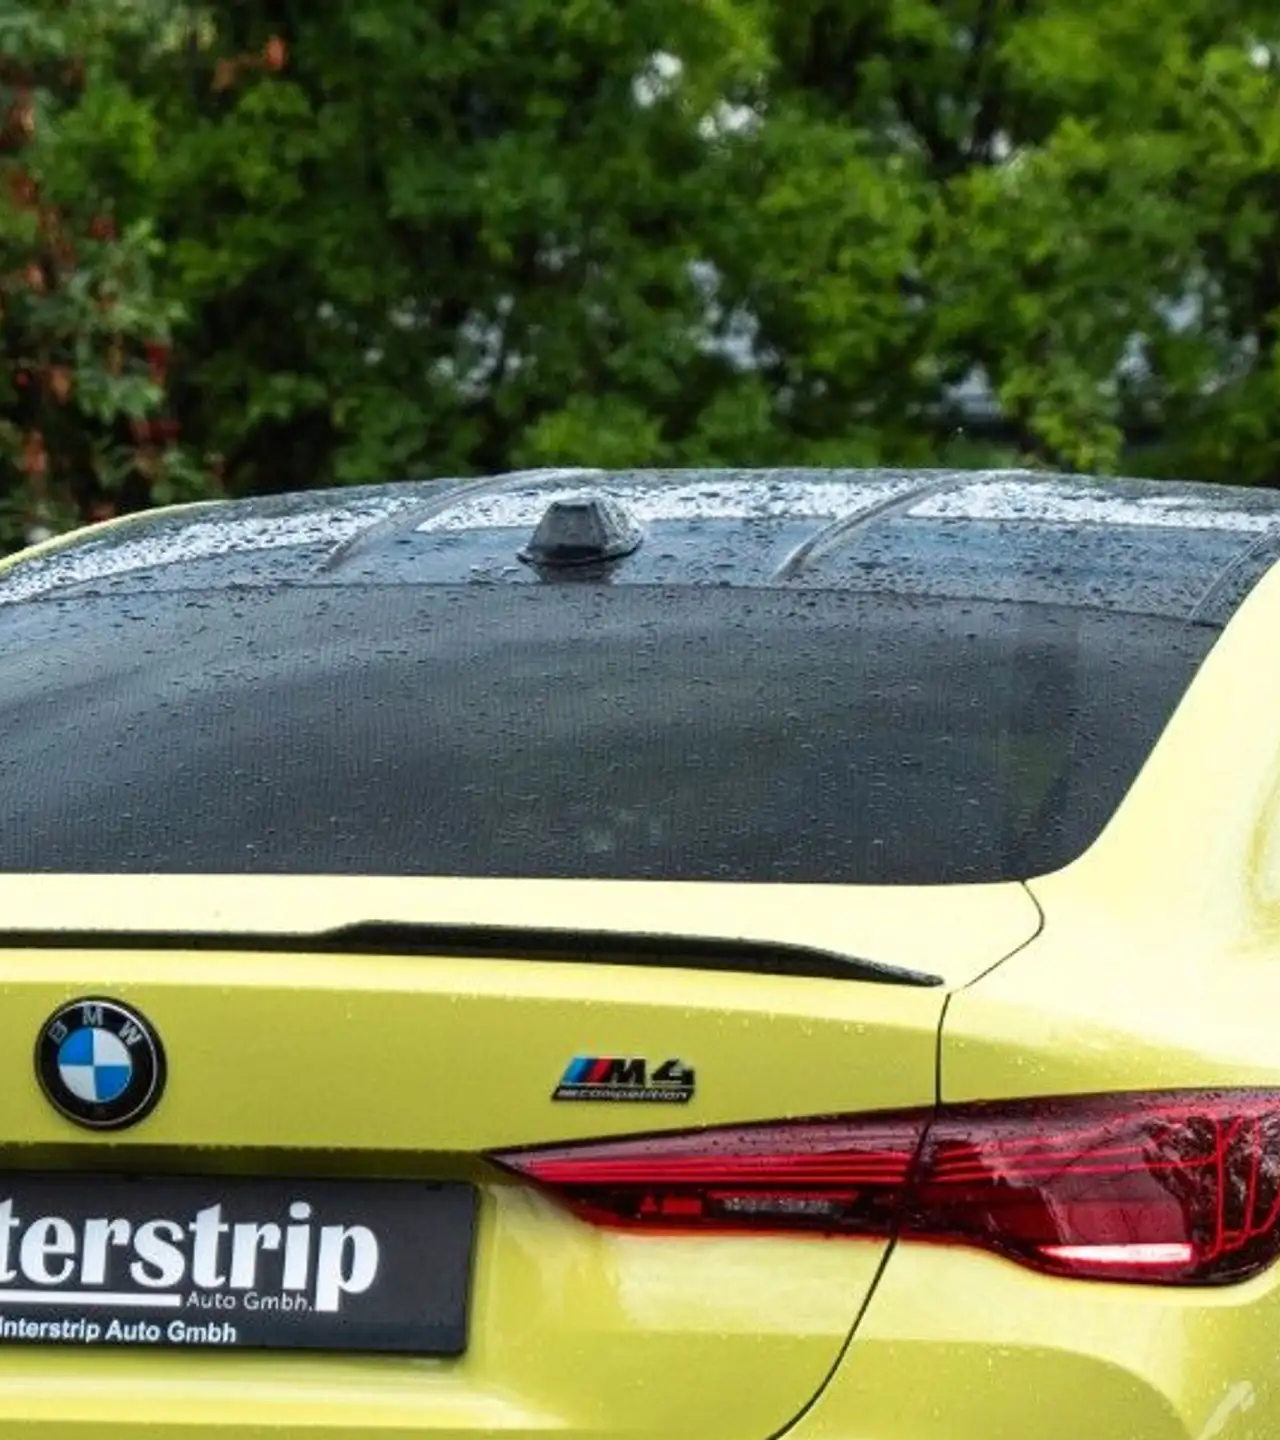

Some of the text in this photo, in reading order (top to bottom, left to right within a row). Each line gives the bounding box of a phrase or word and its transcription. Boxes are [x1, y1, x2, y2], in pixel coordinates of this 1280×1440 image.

[47, 1004, 142, 1046] BMW
[606, 1057, 696, 1086] M4
[186, 1290, 314, 1312] Auto Gmbh.
[105, 1318, 161, 1342] Auto
[167, 1319, 237, 1343] Gmbh
